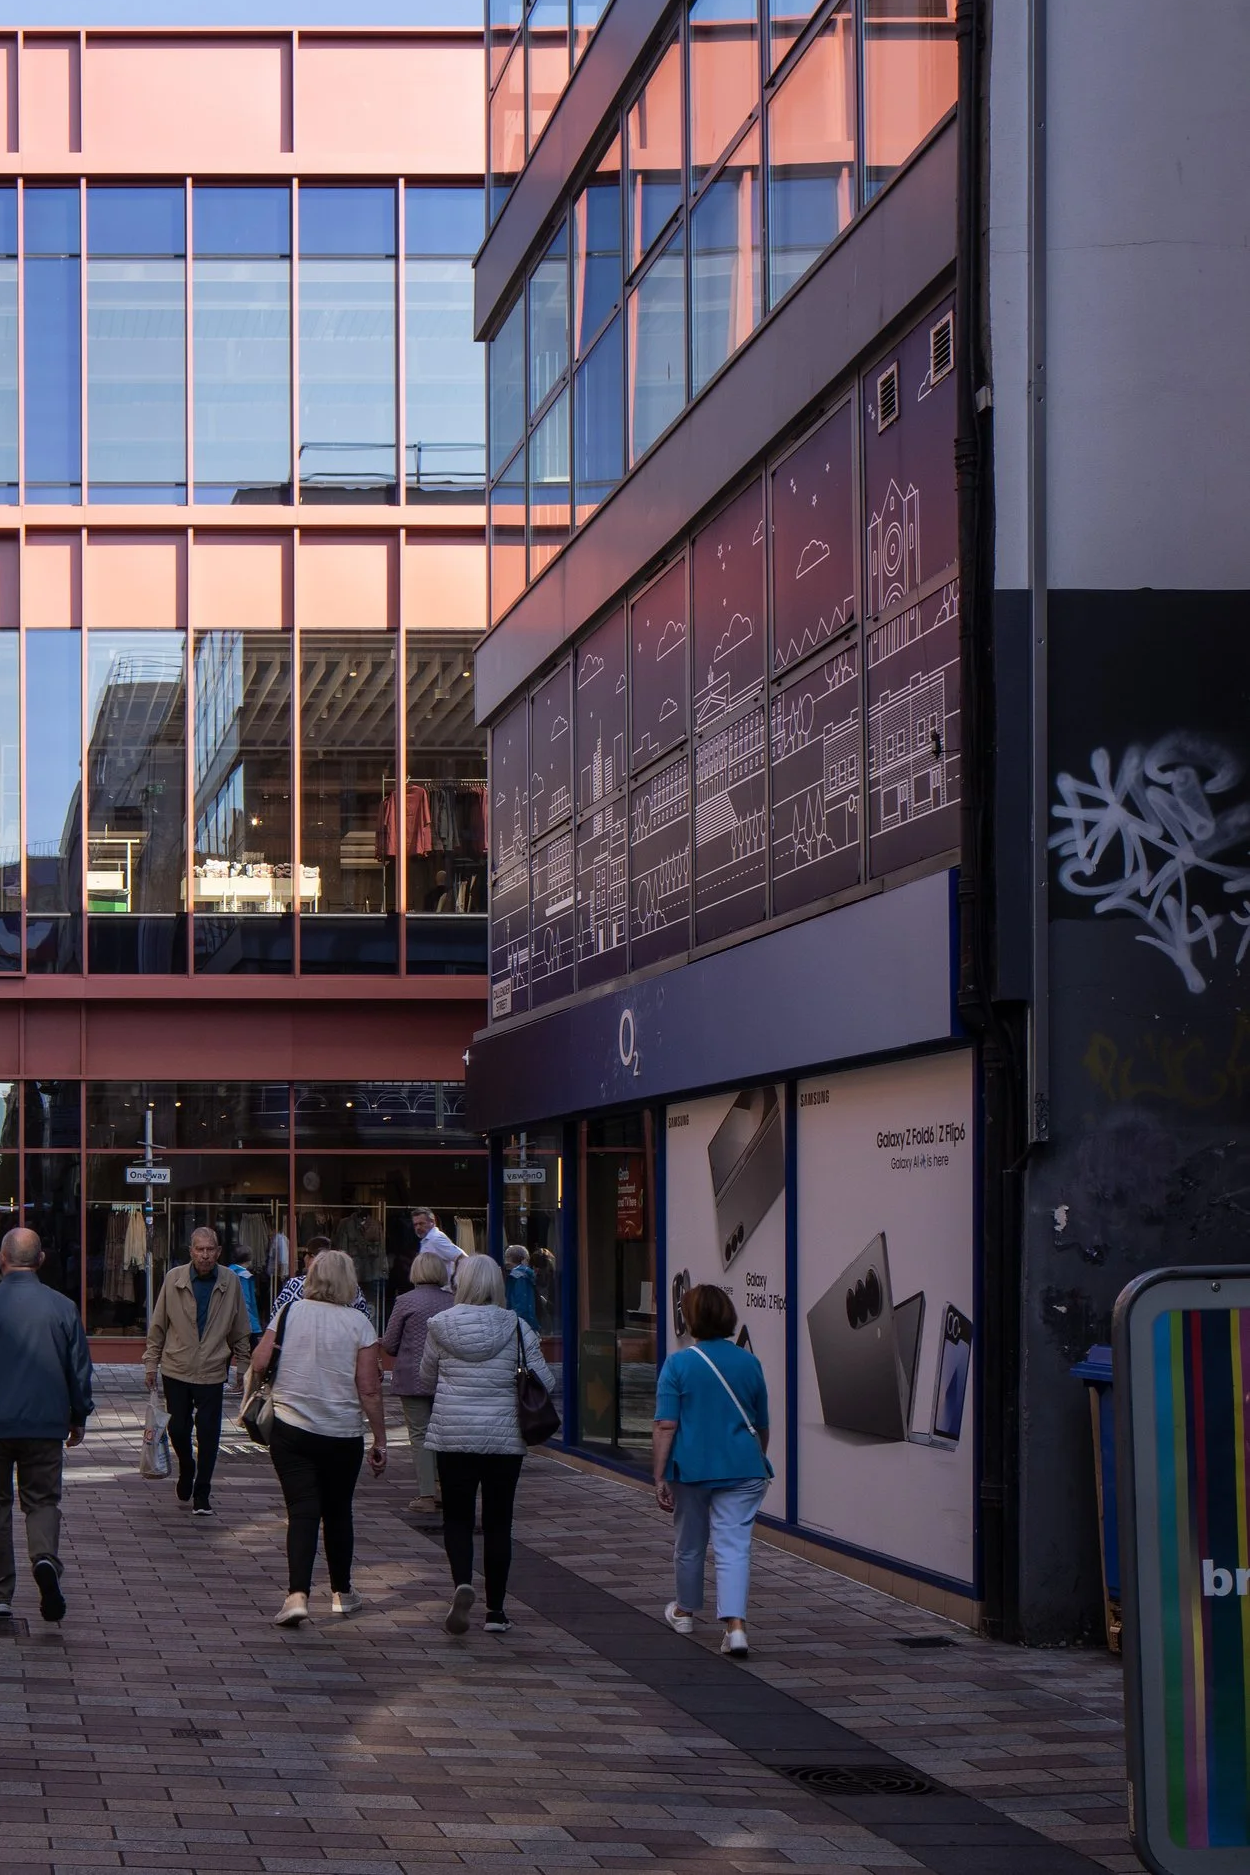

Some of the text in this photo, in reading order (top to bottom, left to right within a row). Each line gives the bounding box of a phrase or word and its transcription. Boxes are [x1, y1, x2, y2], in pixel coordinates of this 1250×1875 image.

[800, 1089, 830, 1108] SAMSUNG
[668, 1113, 690, 1129] SAMSUNG
[876, 1122, 966, 1152] Galaxy Z Fold6 Z Flip6
[891, 1156, 912, 1172] Galaxy
[926, 1153, 932, 1167] is
[933, 1154, 949, 1166] here
[129, 1170, 168, 1181] One way
[746, 1272, 767, 1292] Galaxy
[746, 1293, 751, 1307] Z
[751, 1293, 766, 1308] Fold6
[769, 1294, 773, 1309] Z
